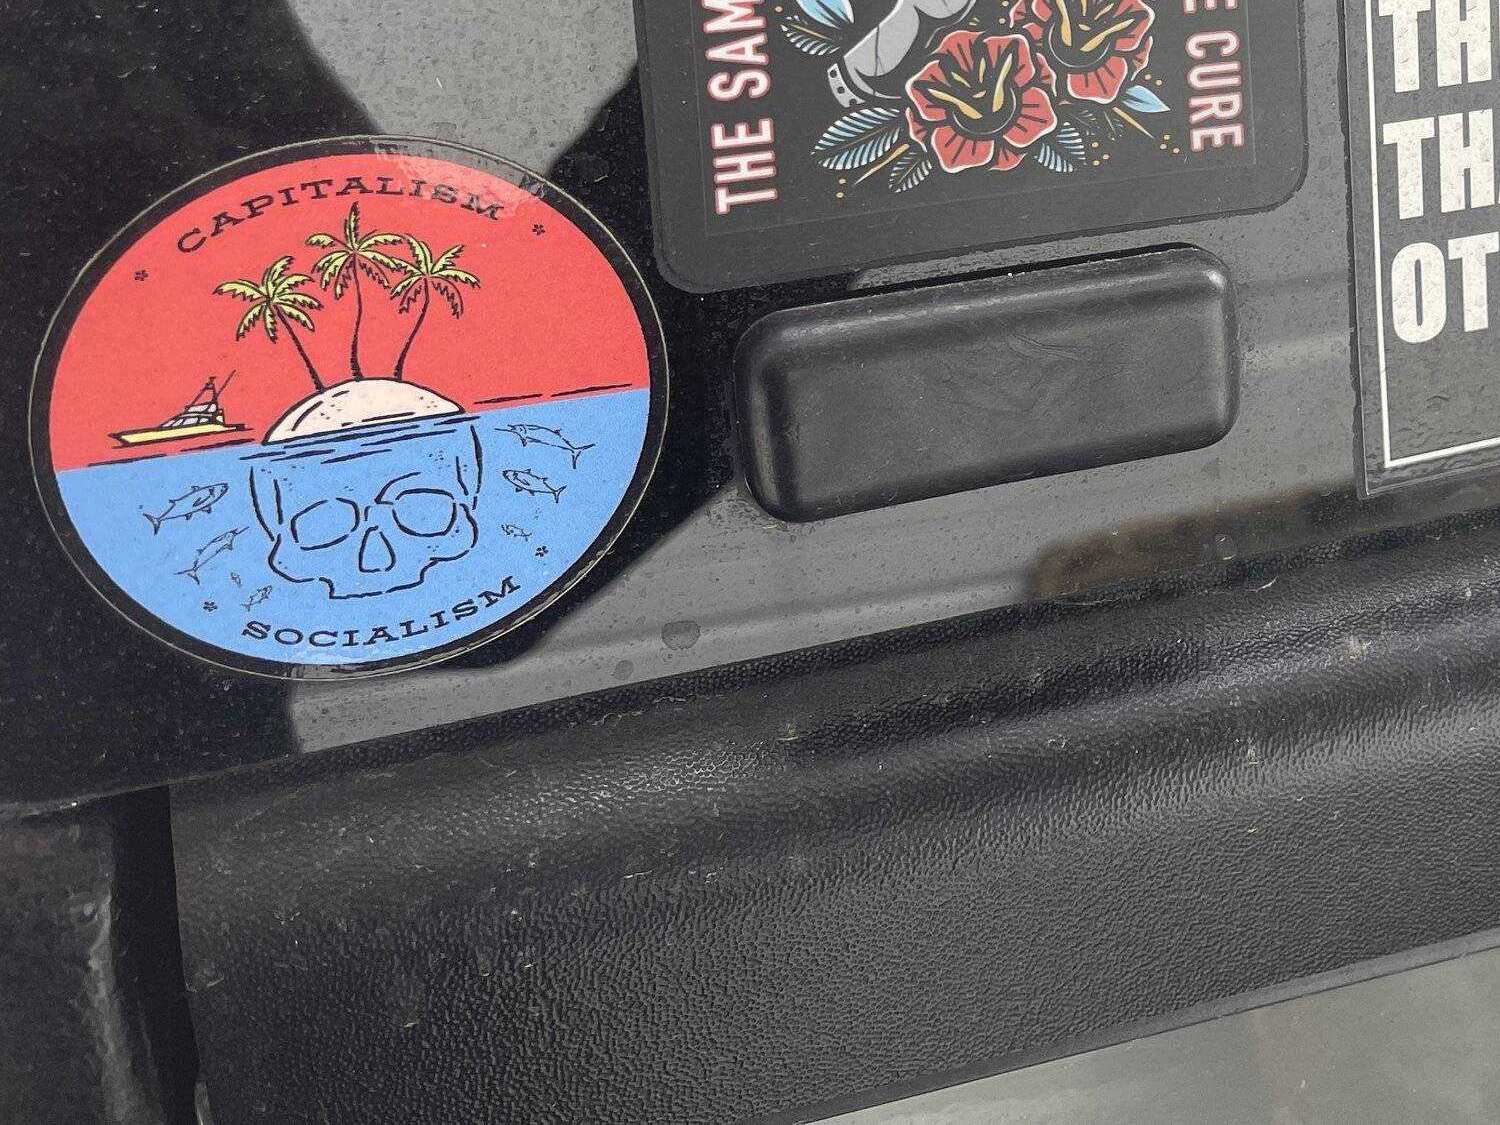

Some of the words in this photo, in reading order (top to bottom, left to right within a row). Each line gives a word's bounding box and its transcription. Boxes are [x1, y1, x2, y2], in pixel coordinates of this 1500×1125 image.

[709, 117, 778, 215] THE
[1185, 31, 1244, 153] CURE
[176, 177, 505, 254] CAPITALISM
[241, 576, 521, 647] SOCIALISM
